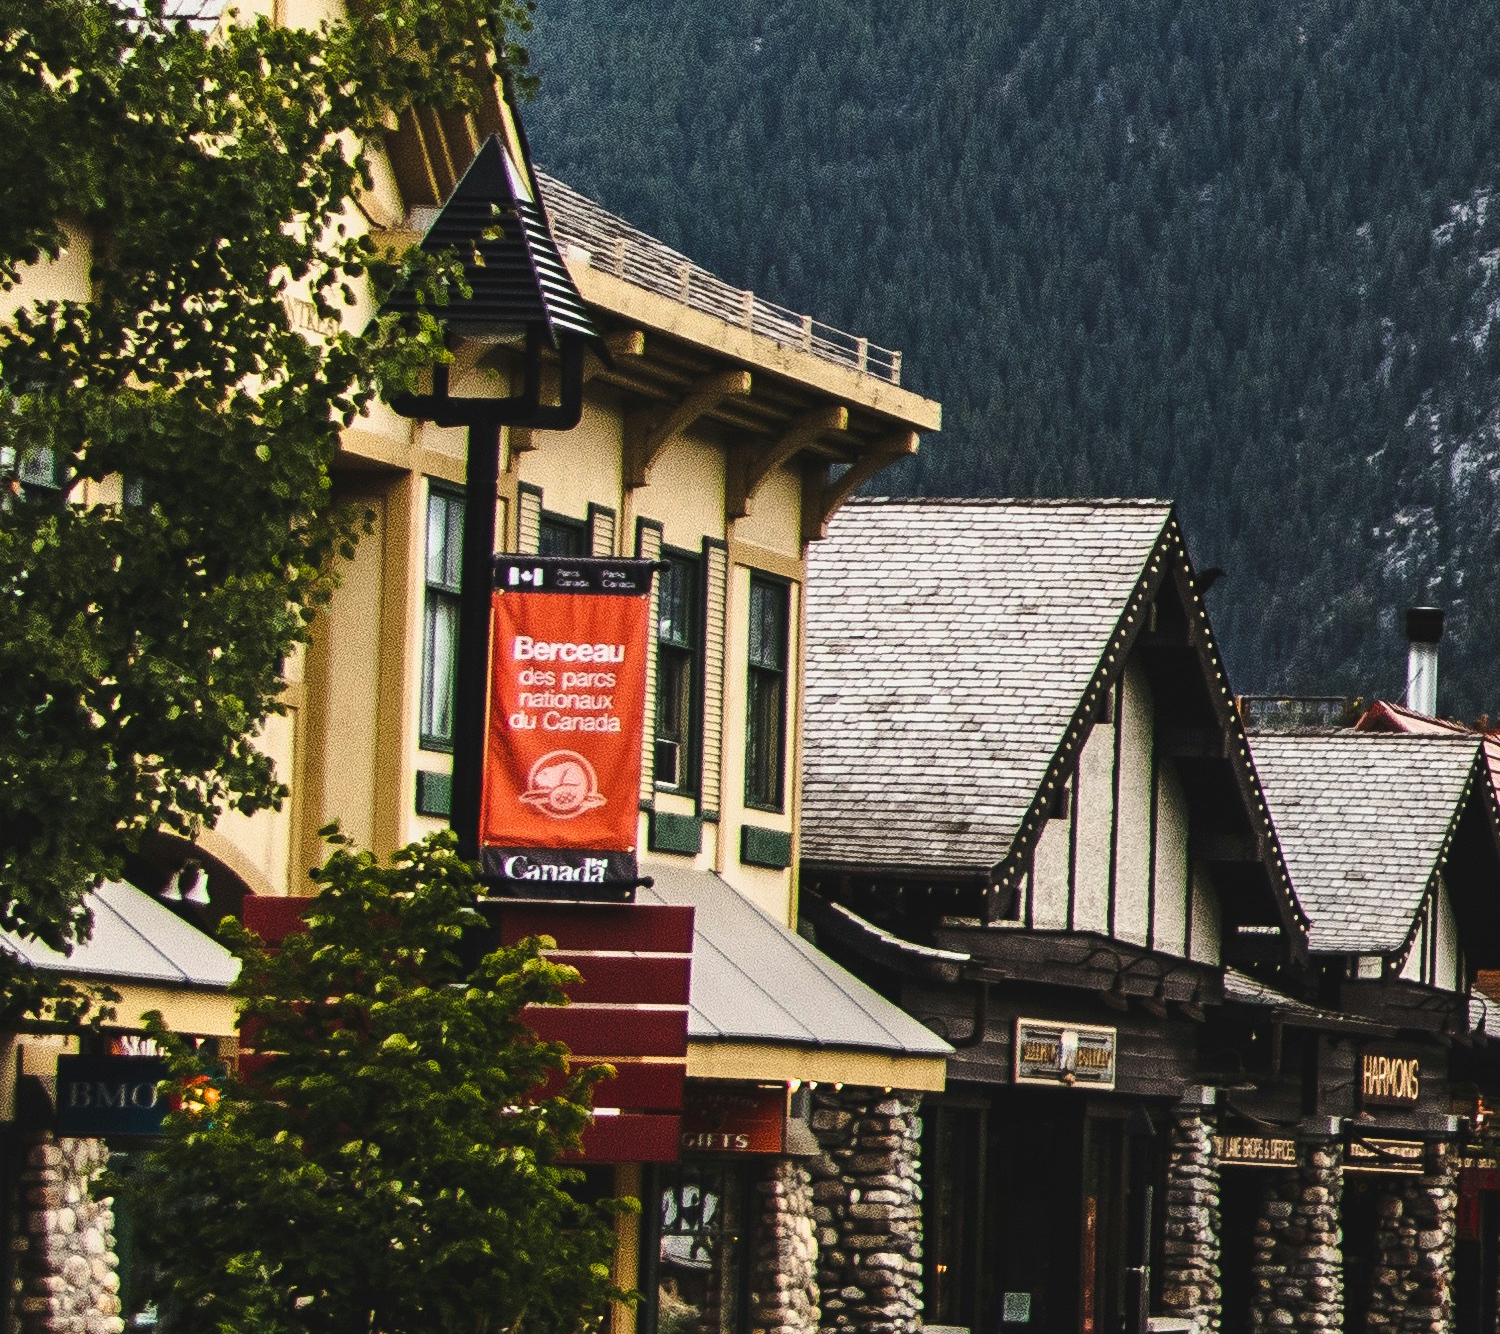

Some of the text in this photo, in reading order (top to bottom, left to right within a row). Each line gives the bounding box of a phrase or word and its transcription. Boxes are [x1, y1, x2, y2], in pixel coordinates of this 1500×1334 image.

[513, 635, 625, 663] Berceau
[517, 667, 617, 691] des parcs
[519, 690, 613, 710] nationaux
[507, 710, 622, 733] du Canada
[504, 855, 608, 883] Canada
[1363, 1054, 1419, 1100] HARMONS
[70, 1081, 158, 1109] BMO
[682, 1132, 750, 1149] GIFTS
